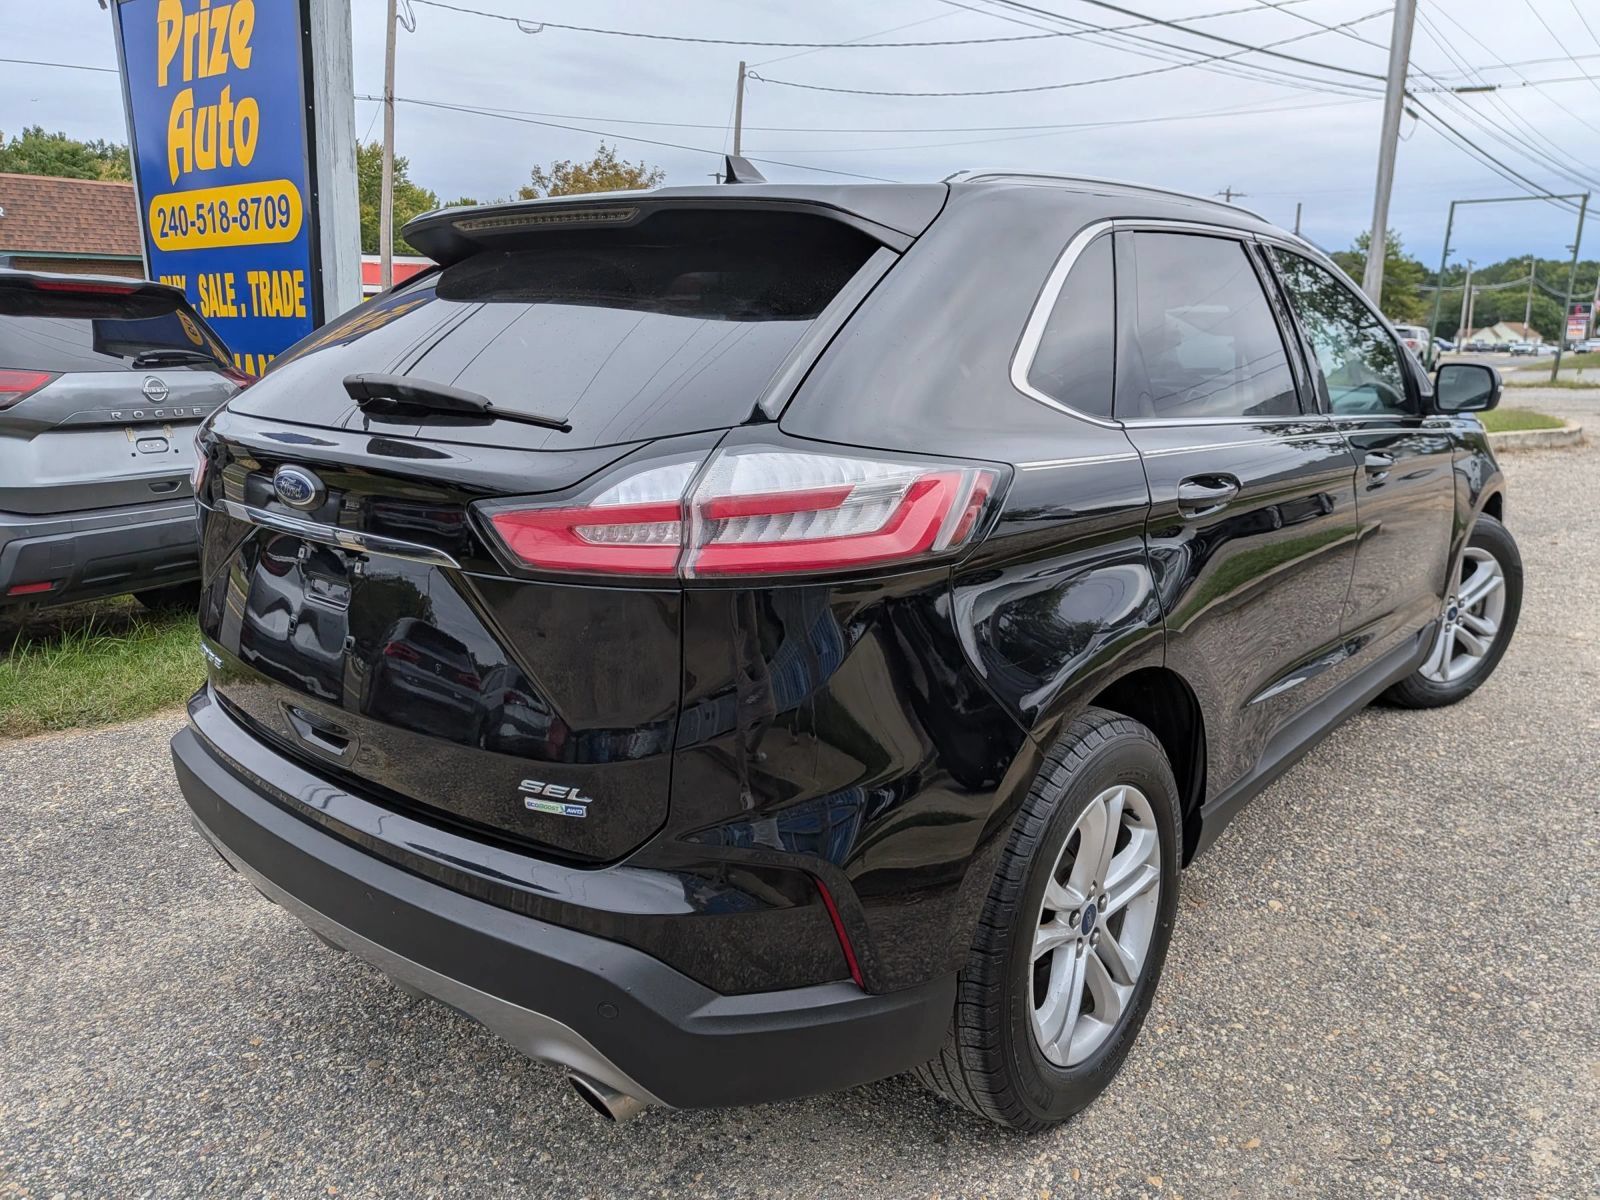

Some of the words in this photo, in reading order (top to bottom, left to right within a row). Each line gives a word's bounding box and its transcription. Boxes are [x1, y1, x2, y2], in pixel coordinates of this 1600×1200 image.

[157, 0, 255, 87] Prize
[168, 83, 259, 186] Auto
[157, 194, 291, 238] 240-518-8709
[247, 270, 306, 317] TRADE
[111, 408, 203, 419] ROGUE
[517, 779, 593, 803] SEL
